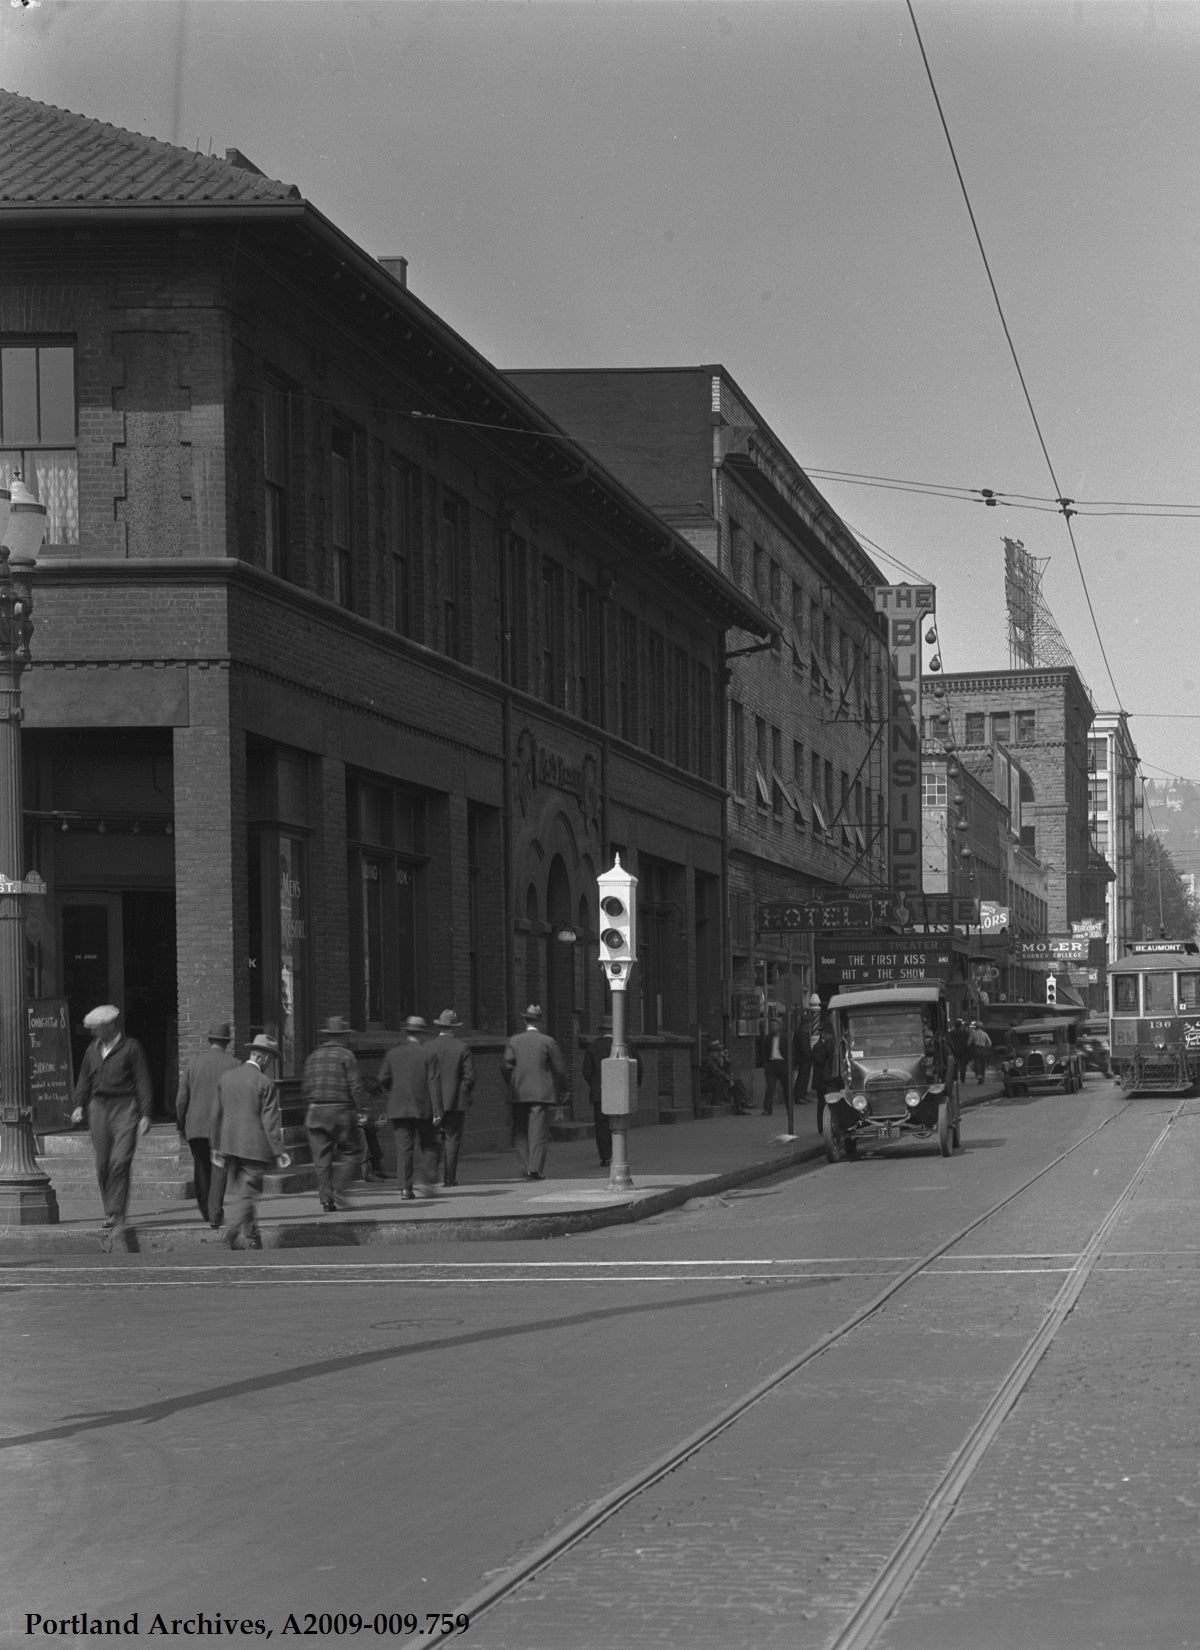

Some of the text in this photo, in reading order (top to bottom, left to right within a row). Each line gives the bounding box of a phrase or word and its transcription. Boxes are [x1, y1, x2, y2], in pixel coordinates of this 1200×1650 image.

[877, 589, 932, 608] THE
[892, 619, 918, 891] BURNSIDE
[830, 940, 938, 951] BURNSIDE THEATER
[1022, 942, 1082, 951] MOLER
[1135, 944, 1182, 952] BEAUMONT
[848, 955, 865, 966] THE
[871, 954, 896, 965] FIRST
[904, 954, 926, 964] KISS
[842, 969, 857, 980] HIT
[877, 969, 894, 979] THE
[900, 968, 925, 979] SHOW
[1150, 1021, 1171, 1029] 136
